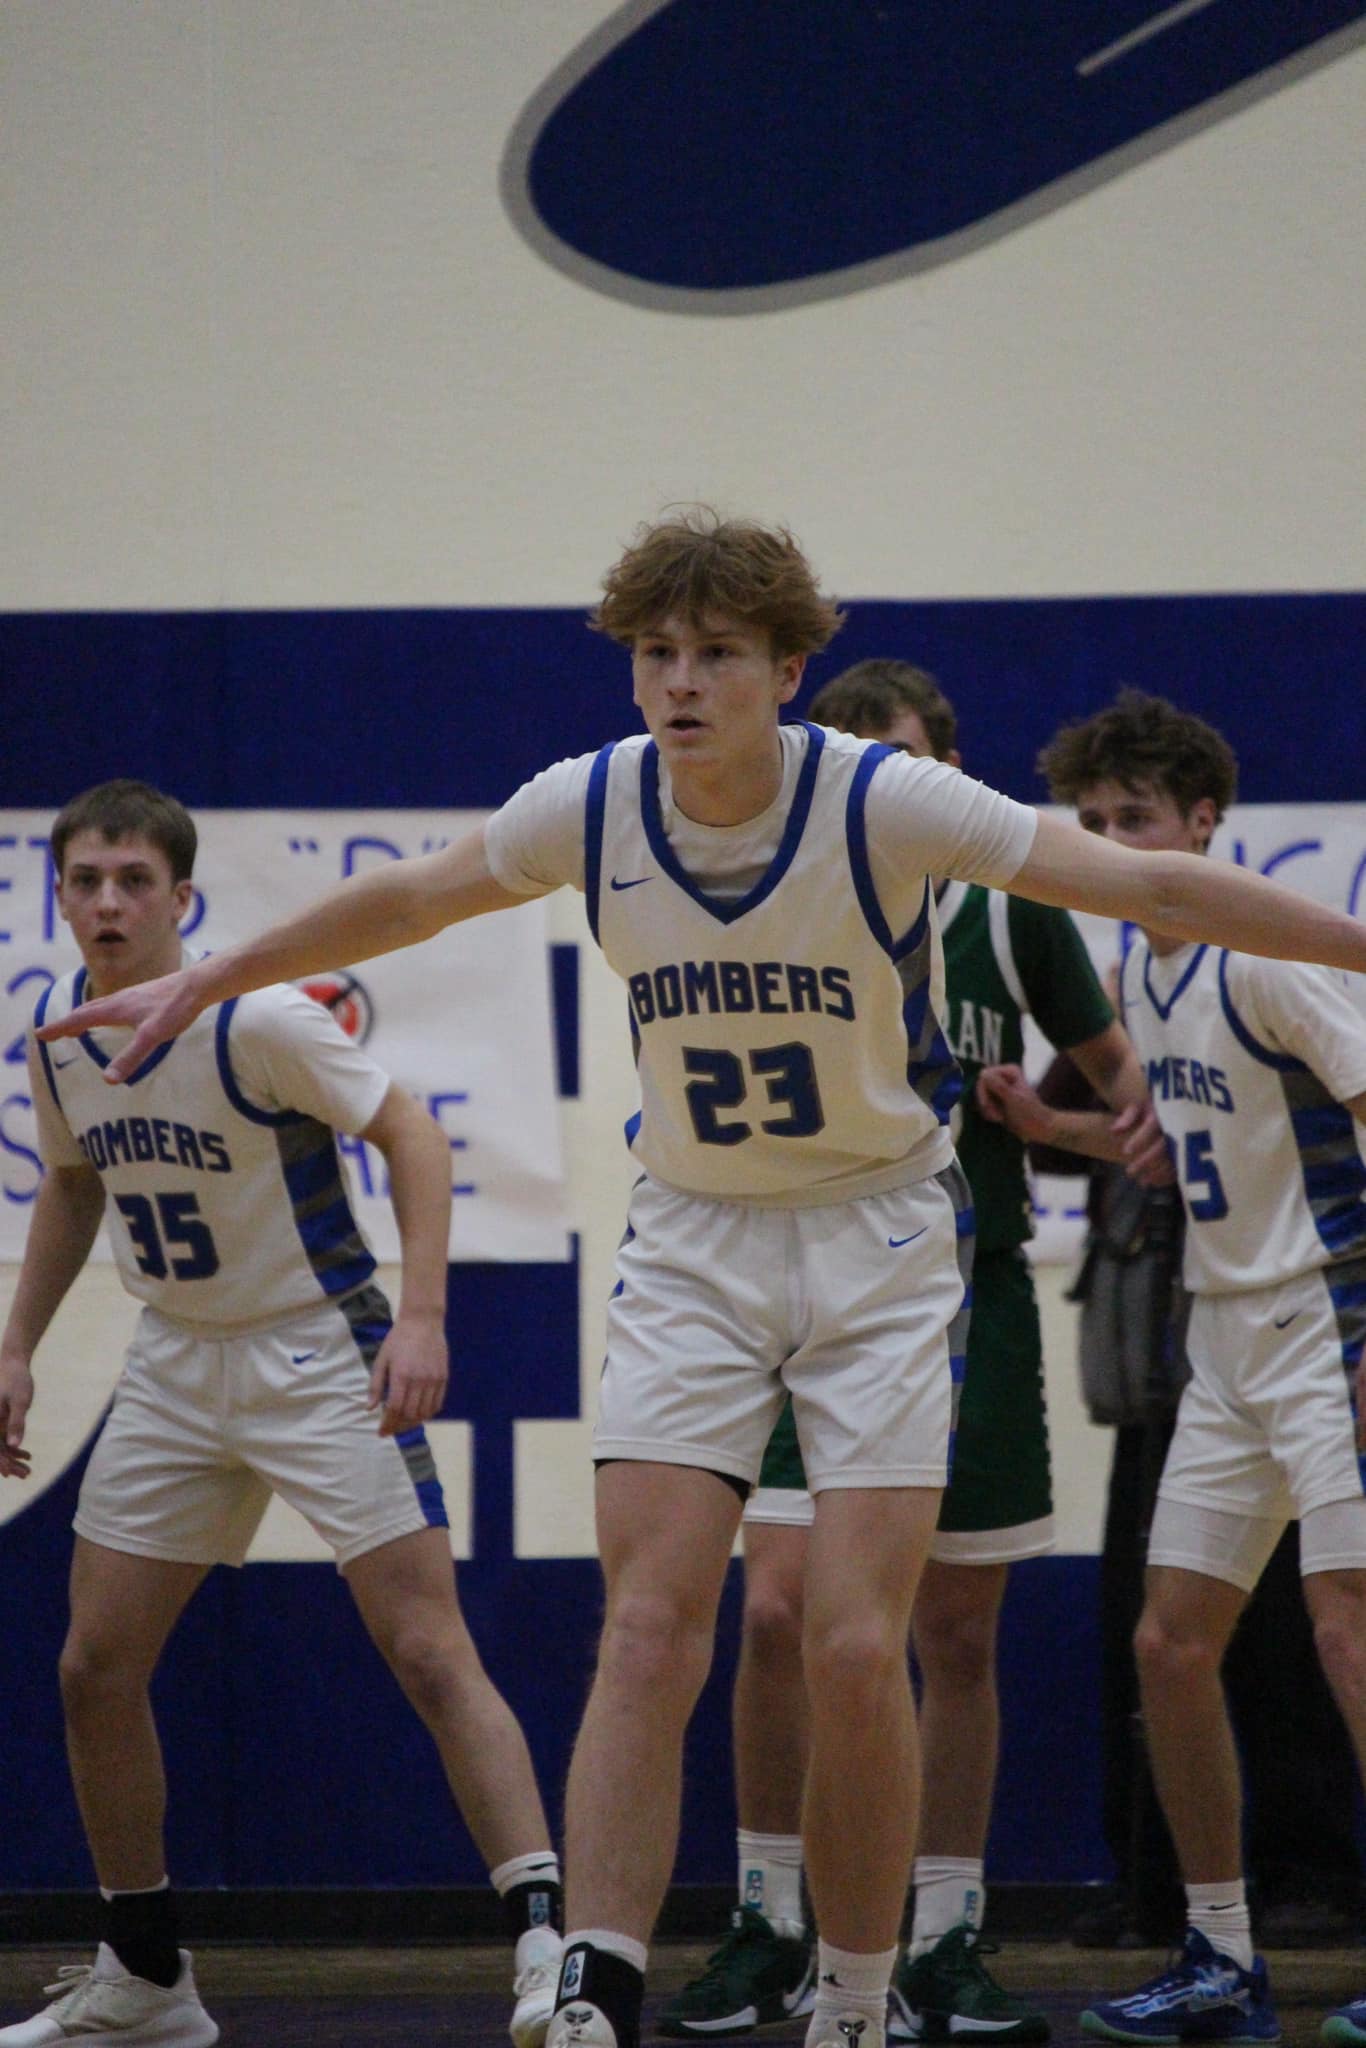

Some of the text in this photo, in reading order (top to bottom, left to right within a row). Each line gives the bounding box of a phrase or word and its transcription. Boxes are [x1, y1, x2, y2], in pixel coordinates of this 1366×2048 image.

[629, 961, 856, 1024] BOMBERS
[682, 1041, 826, 1146] 23
[1166, 1130, 1229, 1222] 5
[113, 1192, 220, 1281] 35
